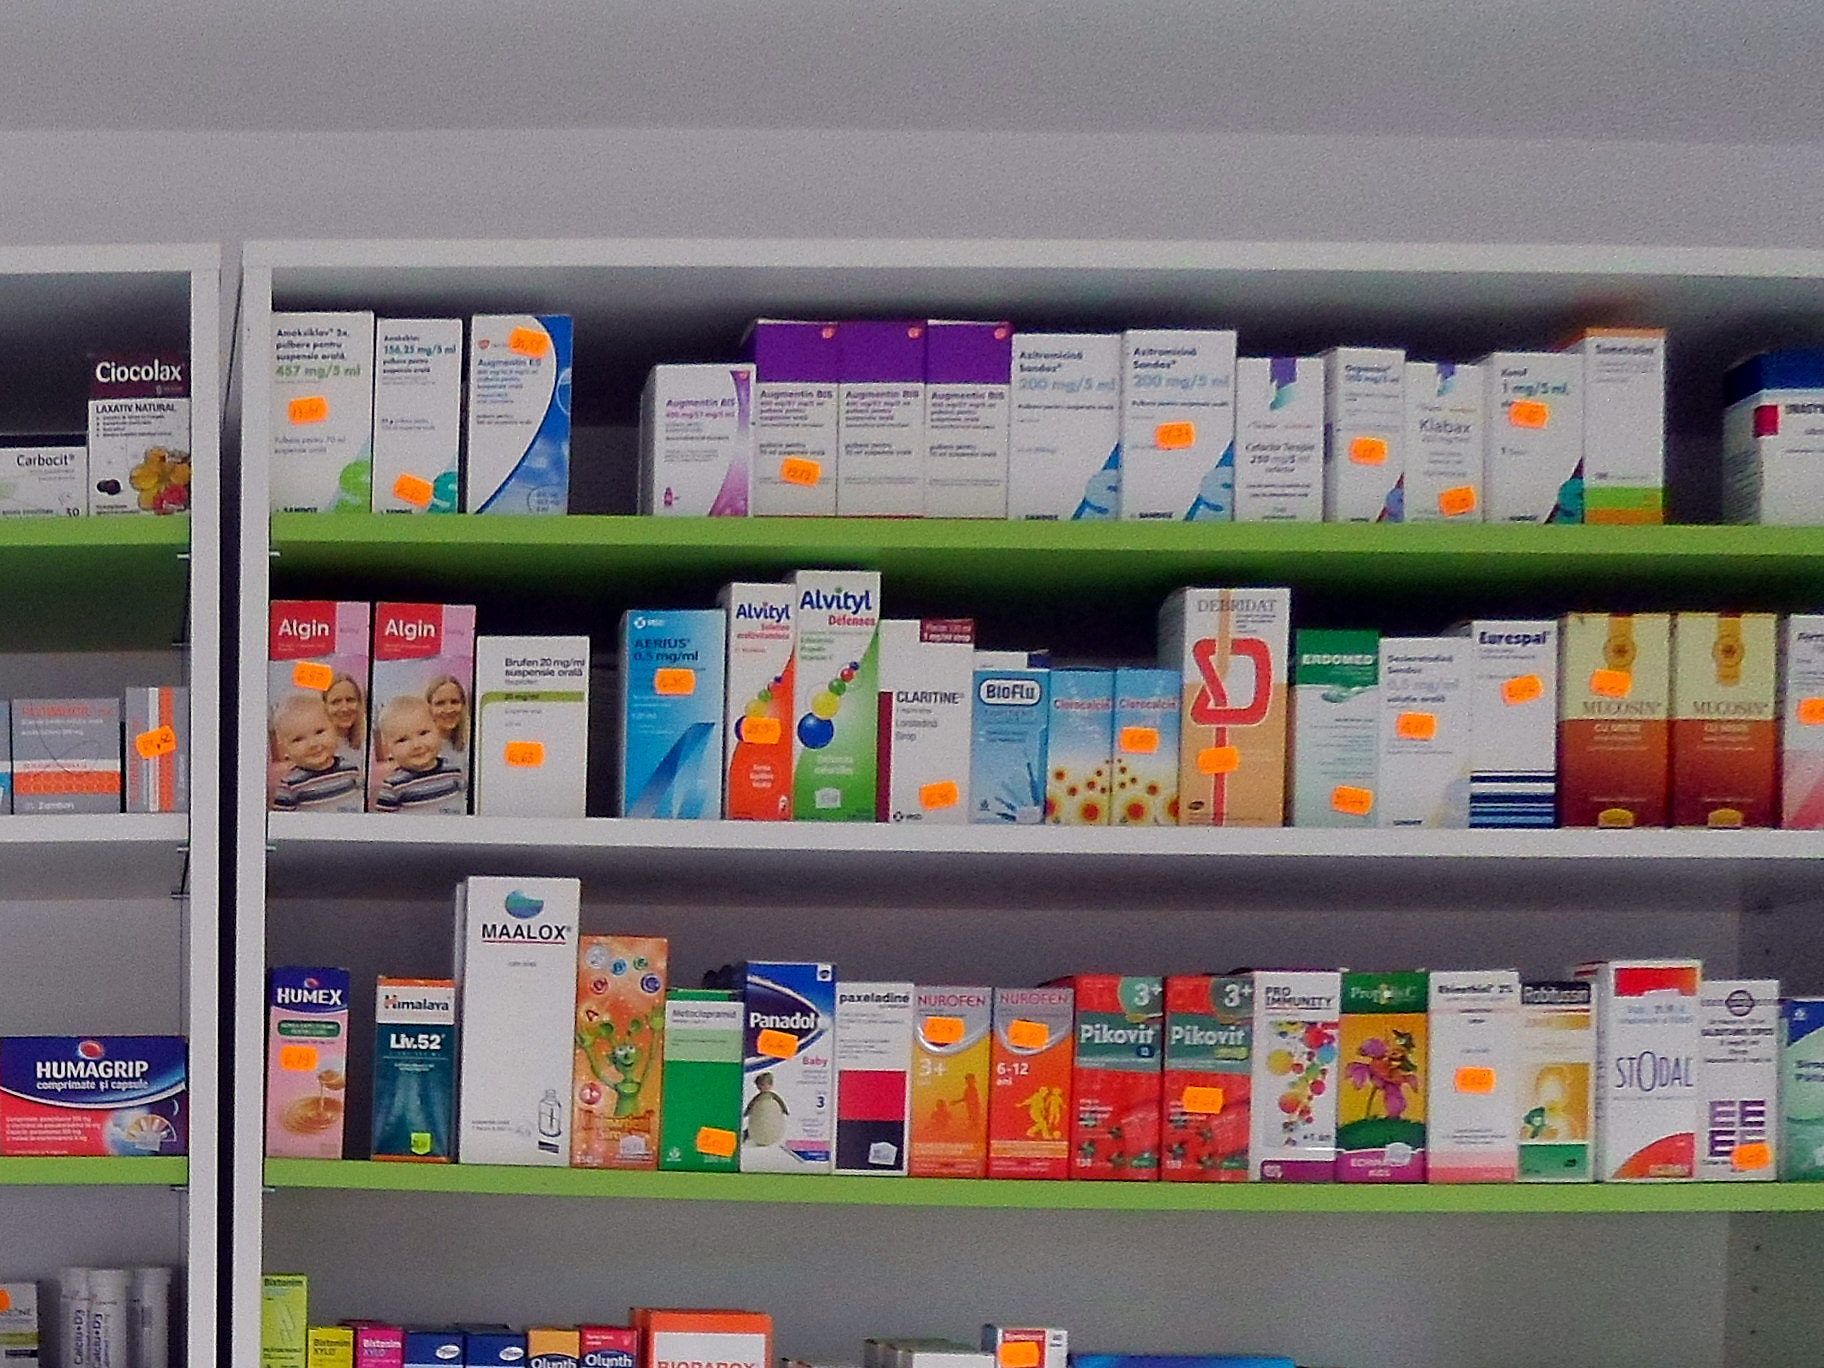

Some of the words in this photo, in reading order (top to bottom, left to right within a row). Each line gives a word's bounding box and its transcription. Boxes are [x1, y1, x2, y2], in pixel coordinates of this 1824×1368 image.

[444, 345, 456, 354] ml
[95, 360, 182, 384] Ciocolax
[308, 364, 342, 380] mg/5
[345, 363, 361, 377] ml
[95, 403, 131, 414] LAXATIV
[134, 403, 175, 413] NATURAL
[16, 453, 68, 468] Carbocit
[800, 588, 872, 615] Alvityl
[1197, 599, 1276, 614] DEBRIDAT
[736, 603, 790, 623] Alvityl
[828, 614, 875, 627] Défenses
[278, 619, 329, 640] Algin
[384, 618, 436, 639] Algin
[635, 638, 686, 650] AERIUS
[1479, 631, 1547, 647] Eurespal
[505, 658, 538, 667] Brufen
[540, 658, 551, 666] 20
[554, 658, 585, 669] mg/ml
[654, 651, 699, 664] mg/ml
[505, 668, 547, 678] suspensie
[896, 691, 959, 704] CLARITINE
[482, 924, 566, 940] MAALOX
[277, 988, 342, 1005] HUMEX
[839, 992, 909, 1005] paxeladine
[1000, 992, 1068, 1004] NUROFEN
[1265, 986, 1291, 996] PRO
[384, 995, 449, 1012] Himalaya
[918, 994, 985, 1008] NUROFEN
[750, 1012, 816, 1030] Panadol
[390, 1034, 441, 1050] Liv.52
[1080, 1024, 1154, 1045] Pikovit
[1170, 1025, 1245, 1046] Pikovit
[37, 1061, 148, 1079] HUMAGRIP
[997, 1063, 1028, 1075] 6-12
[37, 1079, 95, 1091] comprimate
[111, 1079, 148, 1090] capsule
[817, 1096, 824, 1108] 3
